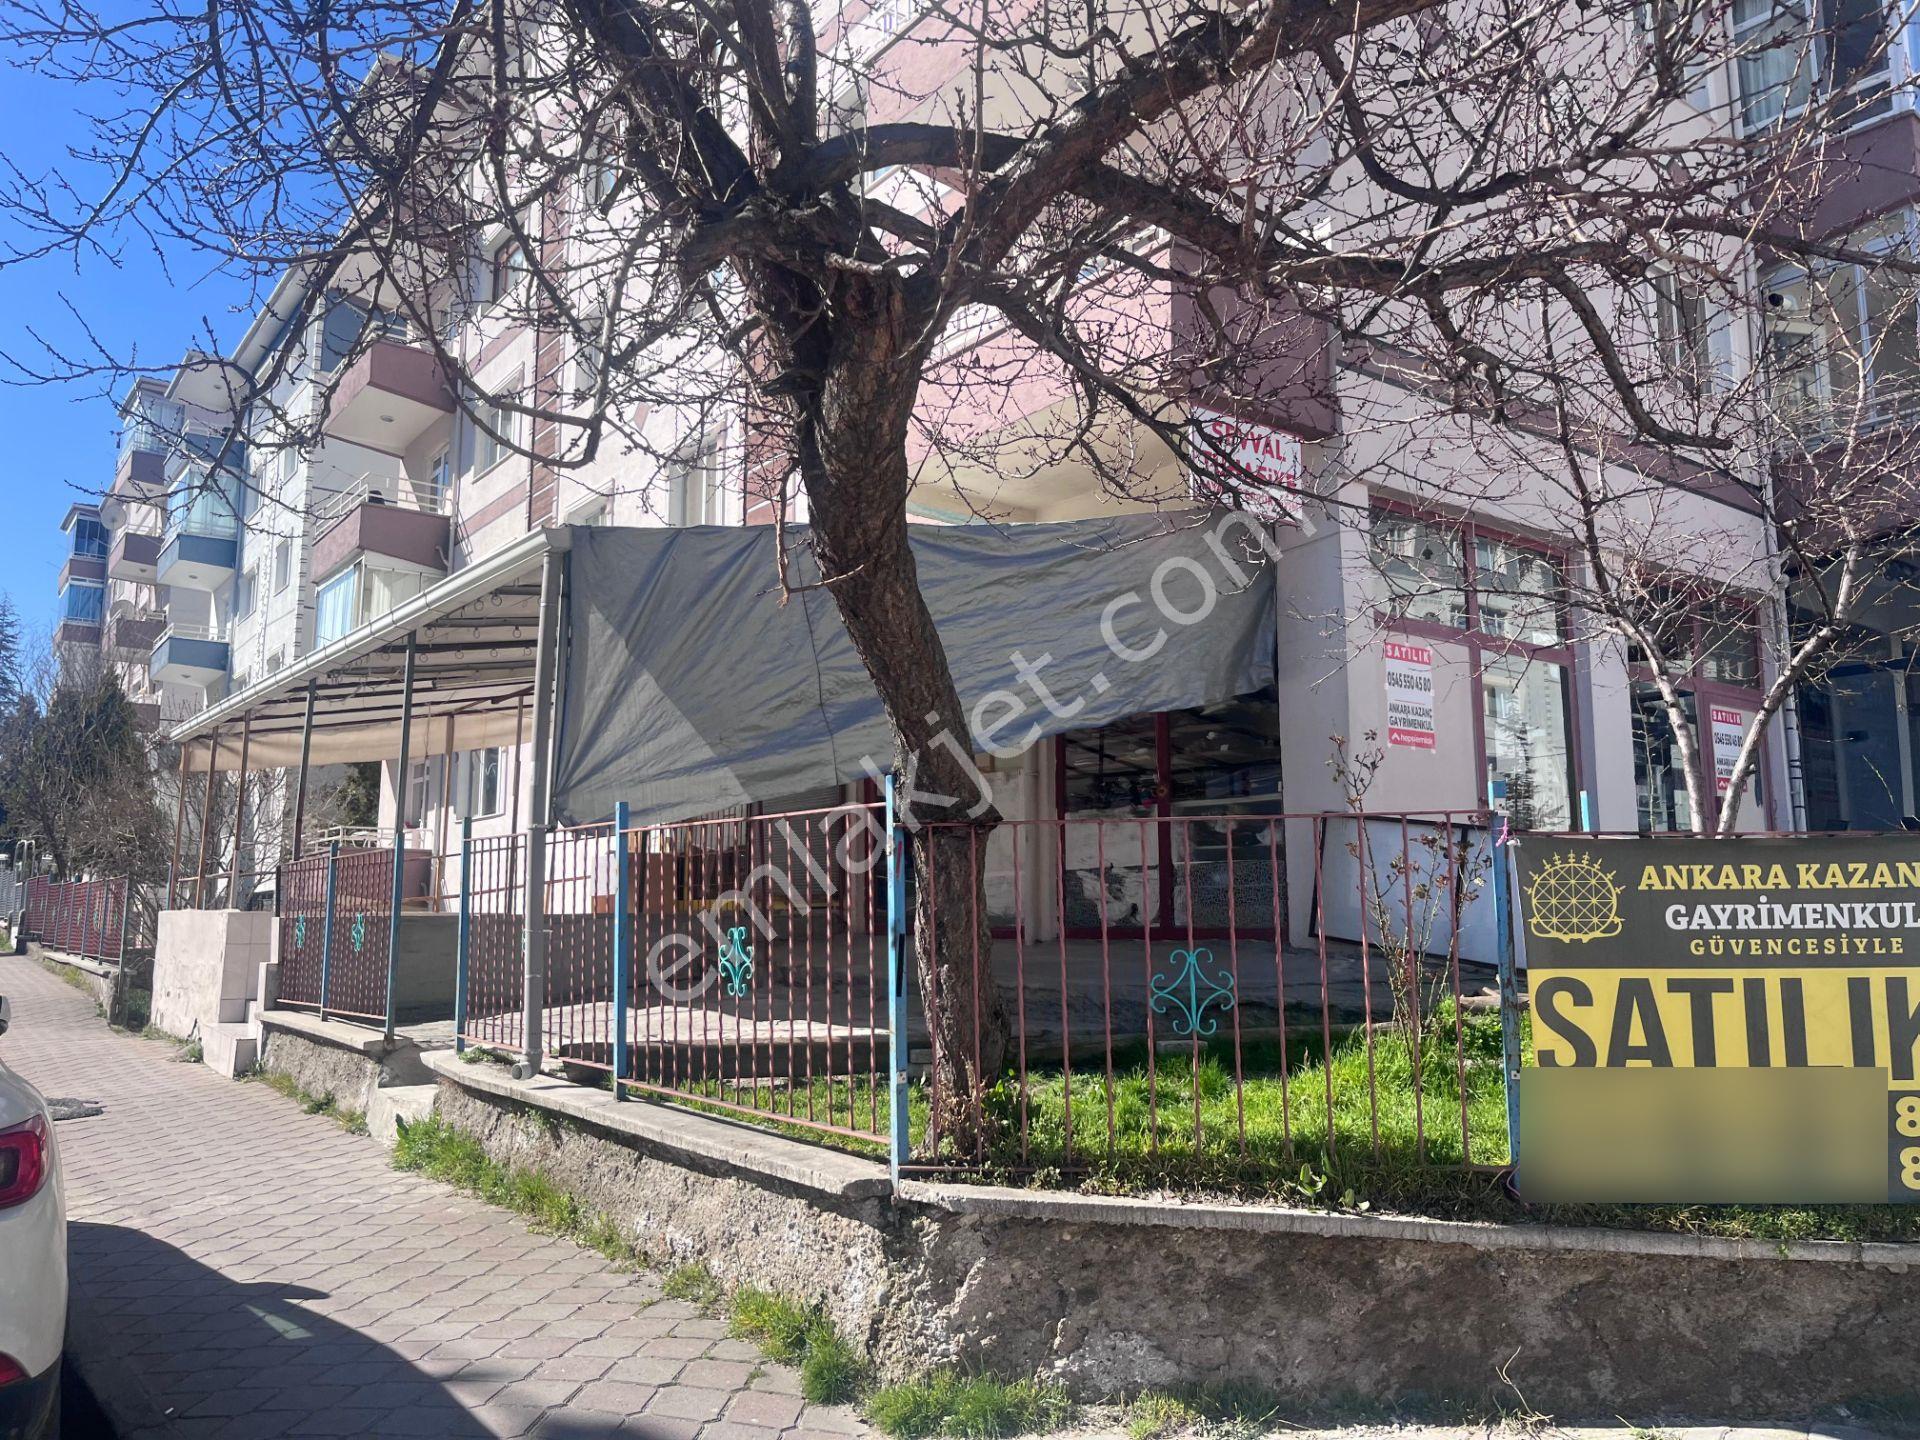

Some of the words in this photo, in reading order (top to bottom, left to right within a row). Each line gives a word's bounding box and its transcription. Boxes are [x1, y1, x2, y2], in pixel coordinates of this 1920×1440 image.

[1386, 644, 1430, 663] SATILIK
[1389, 702, 1410, 715] ANKARA
[1713, 711, 1741, 724] SATILIK
[1638, 863, 1791, 890] ANKARA
[1796, 862, 1920, 889] KAZAN
[1665, 895, 1920, 930] GAYRİMENKUL
[1690, 933, 1904, 955] GÜVENCESİYLE
